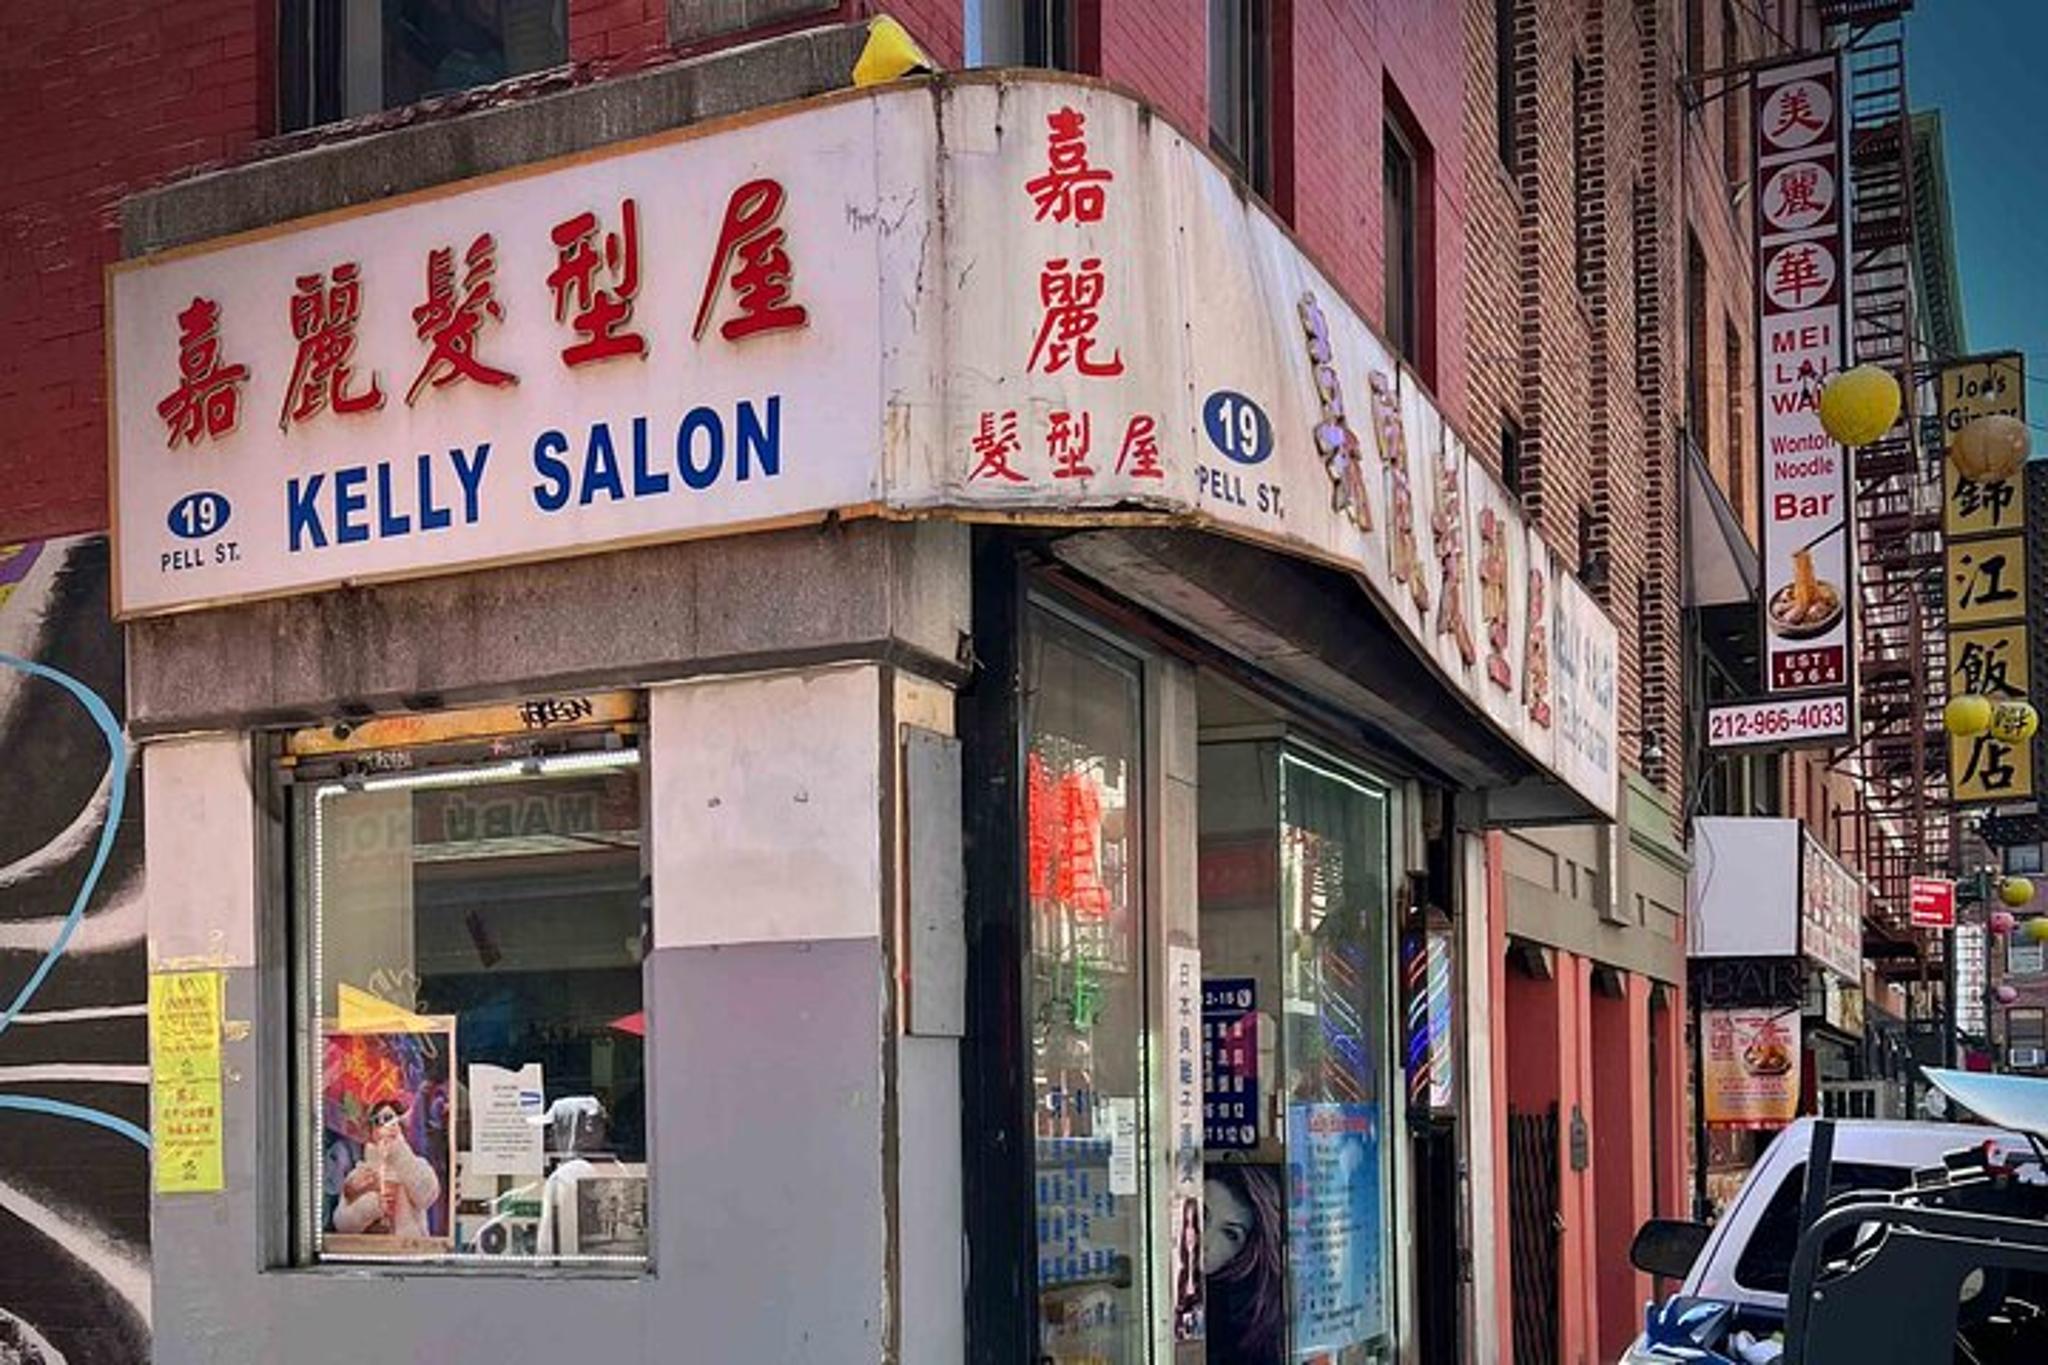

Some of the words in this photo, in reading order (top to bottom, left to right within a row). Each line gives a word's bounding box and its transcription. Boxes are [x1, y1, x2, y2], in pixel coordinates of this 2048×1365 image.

[1025, 106, 1125, 377] 嘉麗
[156, 178, 808, 449] 嘉麗髮型屋
[1772, 325, 1830, 353] MEI
[967, 411, 1166, 483] 髮型屋
[1217, 403, 1258, 457] 19
[287, 443, 491, 552] KELLY
[532, 395, 780, 512] SALON
[1774, 456, 1835, 481] Noodle
[180, 495, 217, 535] 19
[1199, 464, 1247, 507] PELL
[1256, 482, 1285, 521] ST.
[1774, 492, 1835, 521] Bar
[161, 549, 206, 573] PELL
[215, 541, 242, 564] ST.
[1711, 702, 1845, 740] 212-966-4033
